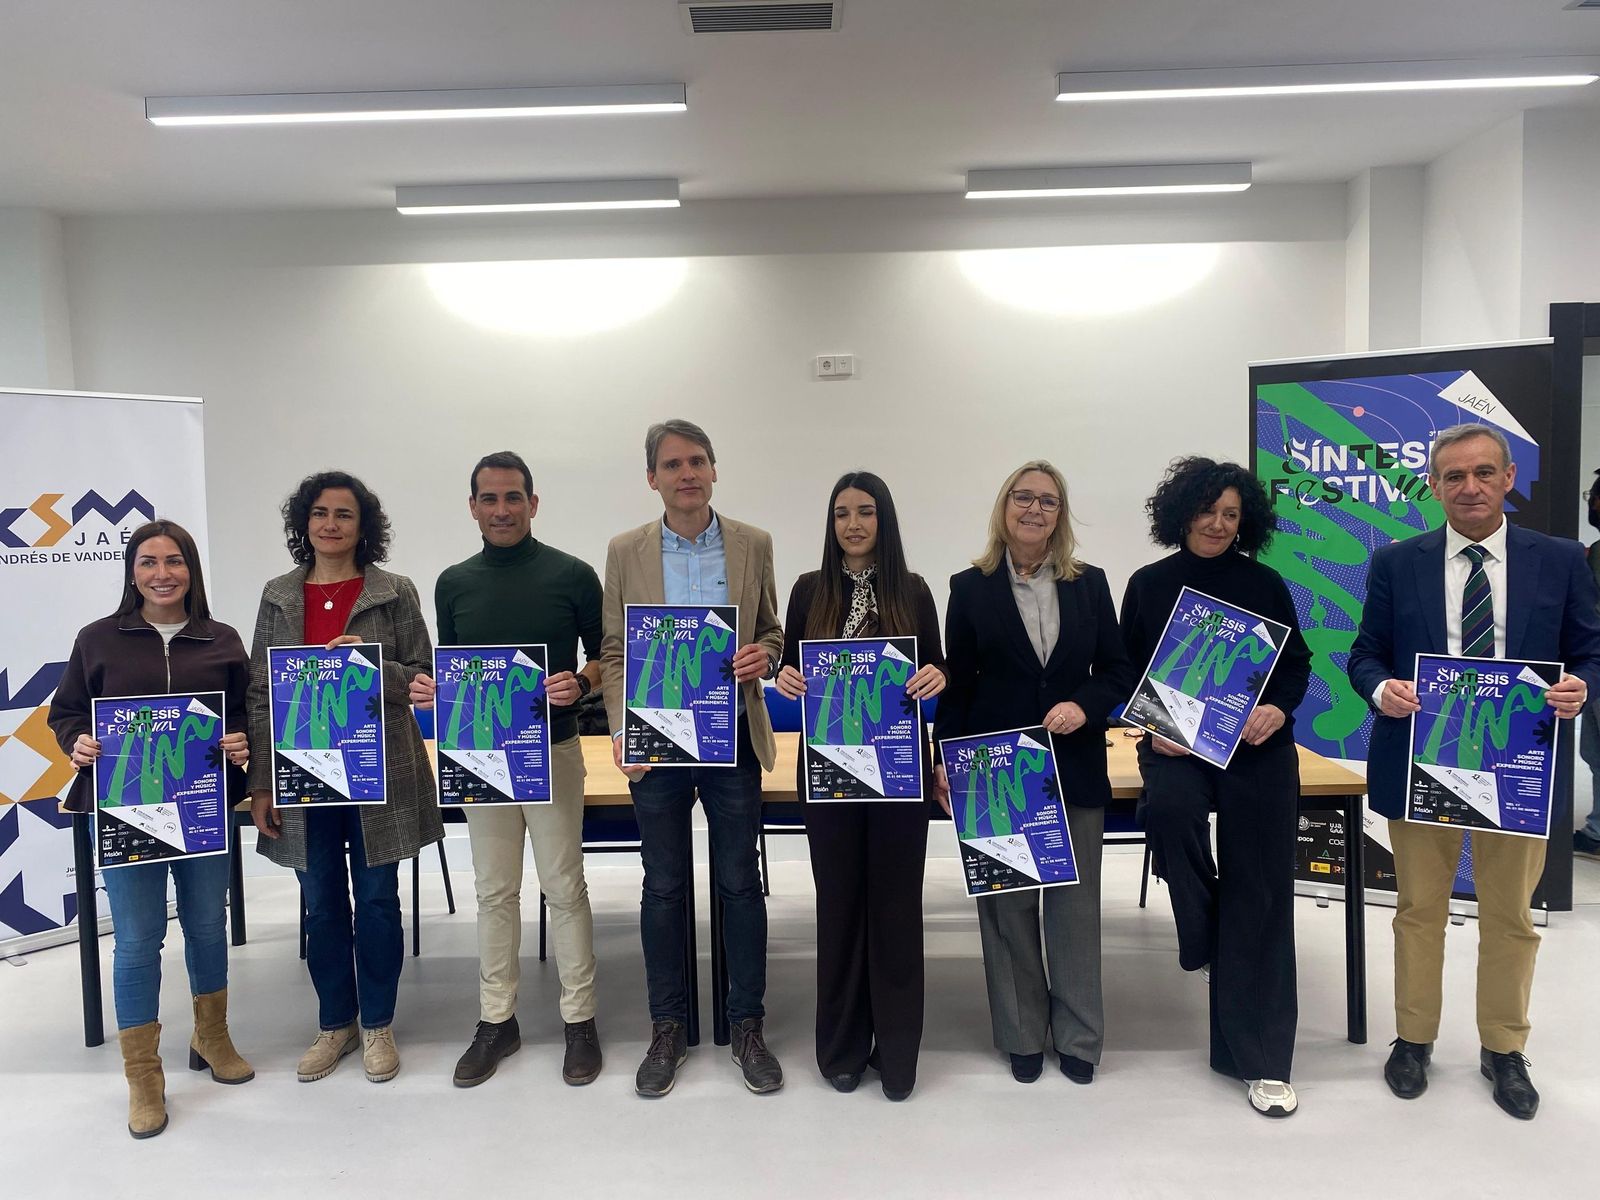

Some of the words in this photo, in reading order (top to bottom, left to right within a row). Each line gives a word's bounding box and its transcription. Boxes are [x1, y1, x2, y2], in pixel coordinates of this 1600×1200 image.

[1458, 394, 1496, 414] JAÉN
[1282, 437, 1434, 474] SÍNTESI
[74, 526, 132, 546] JAÉ
[0, 551, 48, 564] NDRÉS
[52, 552, 70, 562] DE
[74, 550, 126, 562] VANDEL
[643, 616, 698, 628] SÍNTESIS
[287, 658, 342, 670] SÍNTESIS
[450, 658, 507, 670] SÍNTESIS
[819, 652, 876, 665] SÍNTESIS
[1437, 667, 1509, 685] SÍNTESIS
[114, 709, 180, 723] SÍNTESIS
[958, 745, 1013, 761] SÍNTESIS
[1496, 763, 1543, 771] EXPERIMENTAL
[1023, 819, 1059, 828] EXPERIMENTAL
